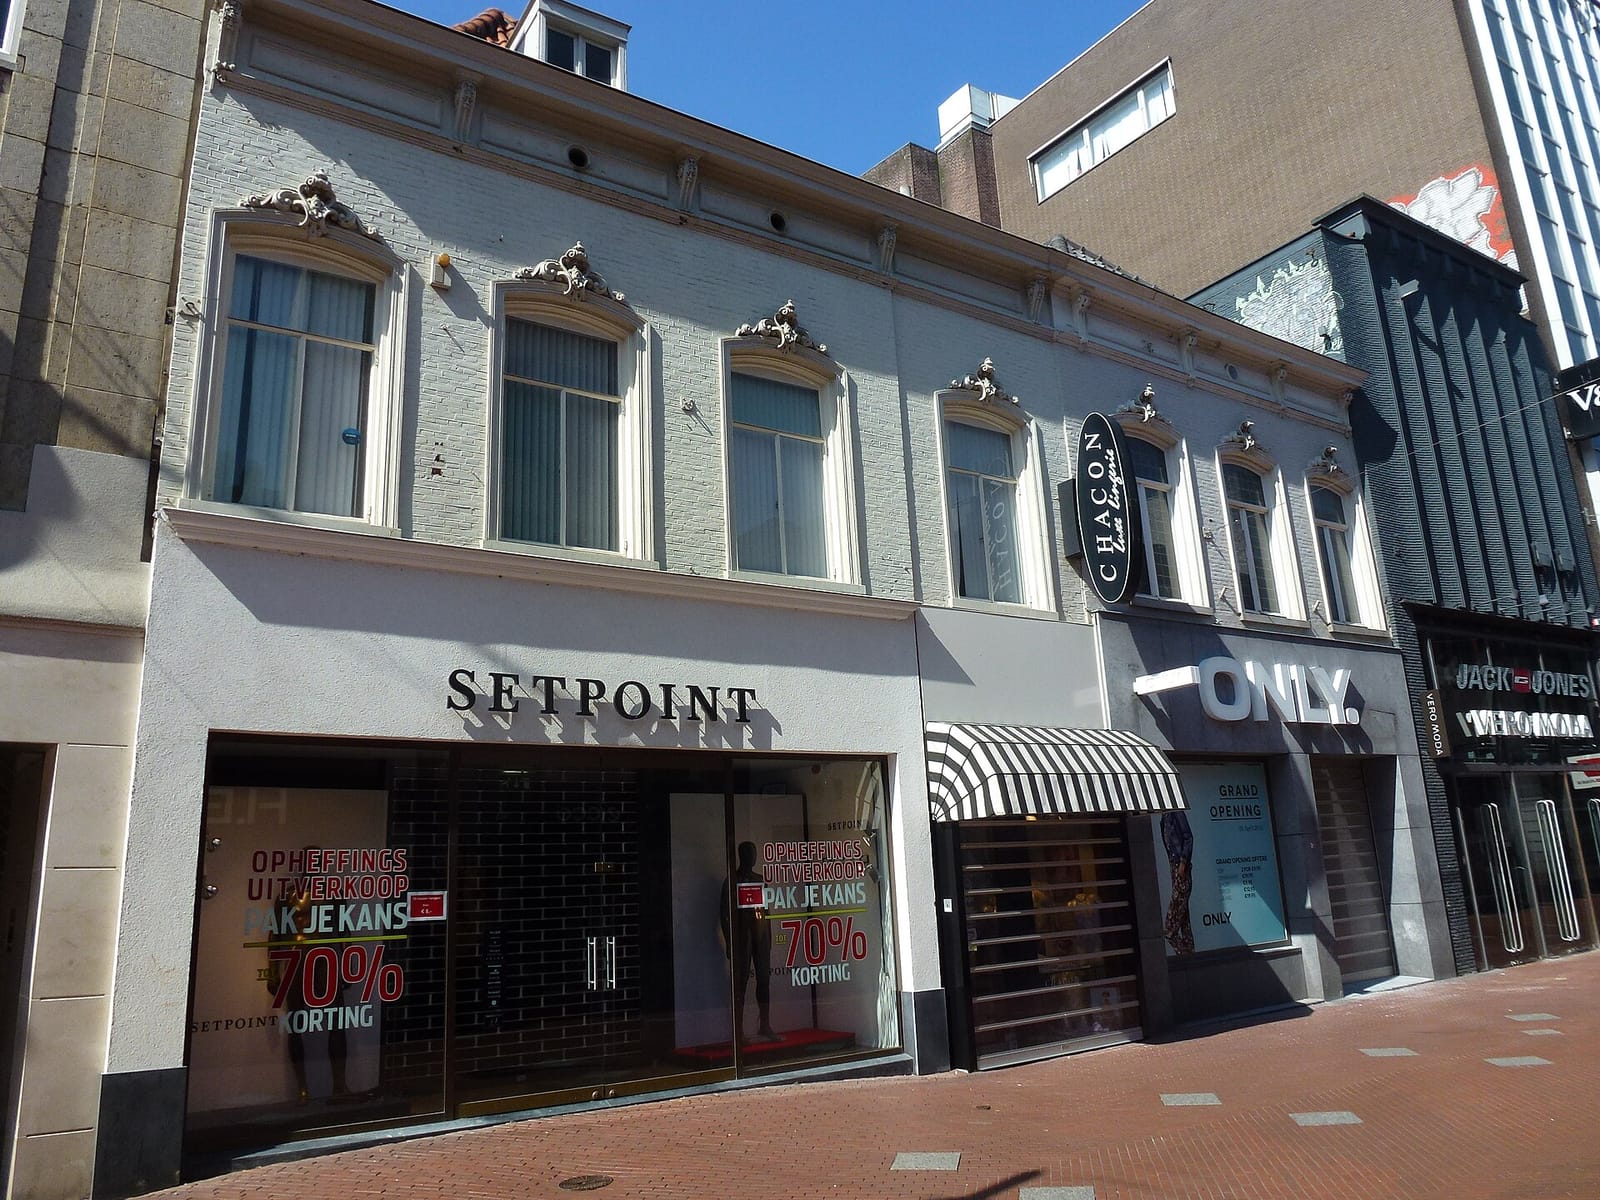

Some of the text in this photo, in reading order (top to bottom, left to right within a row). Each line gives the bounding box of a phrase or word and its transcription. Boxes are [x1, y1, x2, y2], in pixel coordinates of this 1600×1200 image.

[1085, 432, 1118, 582] CHACON
[1456, 663, 1592, 698] JACK JONES
[446, 668, 758, 724] SETPOINT
[1426, 693, 1443, 756] VERO MODA
[1457, 709, 1531, 738] VERO
[1219, 784, 1258, 798] GRAND
[1210, 805, 1262, 819] OPENING
[252, 848, 408, 873] OPHEFFINGS
[763, 840, 862, 862] OPHEFFINGS
[763, 861, 865, 884] UITVERKOOP
[247, 874, 410, 901] UITVERKOOP
[764, 884, 797, 910] PAK
[802, 884, 820, 909] JE
[822, 882, 867, 905] KANS
[243, 901, 409, 936] PAK JE KANS
[1202, 911, 1233, 927] ONLY
[781, 915, 868, 968] 70%
[269, 945, 404, 1009] 70%
[791, 962, 850, 987] KORTING
[190, 1015, 279, 1033] SETPOINT
[277, 1004, 373, 1036] KORTING
